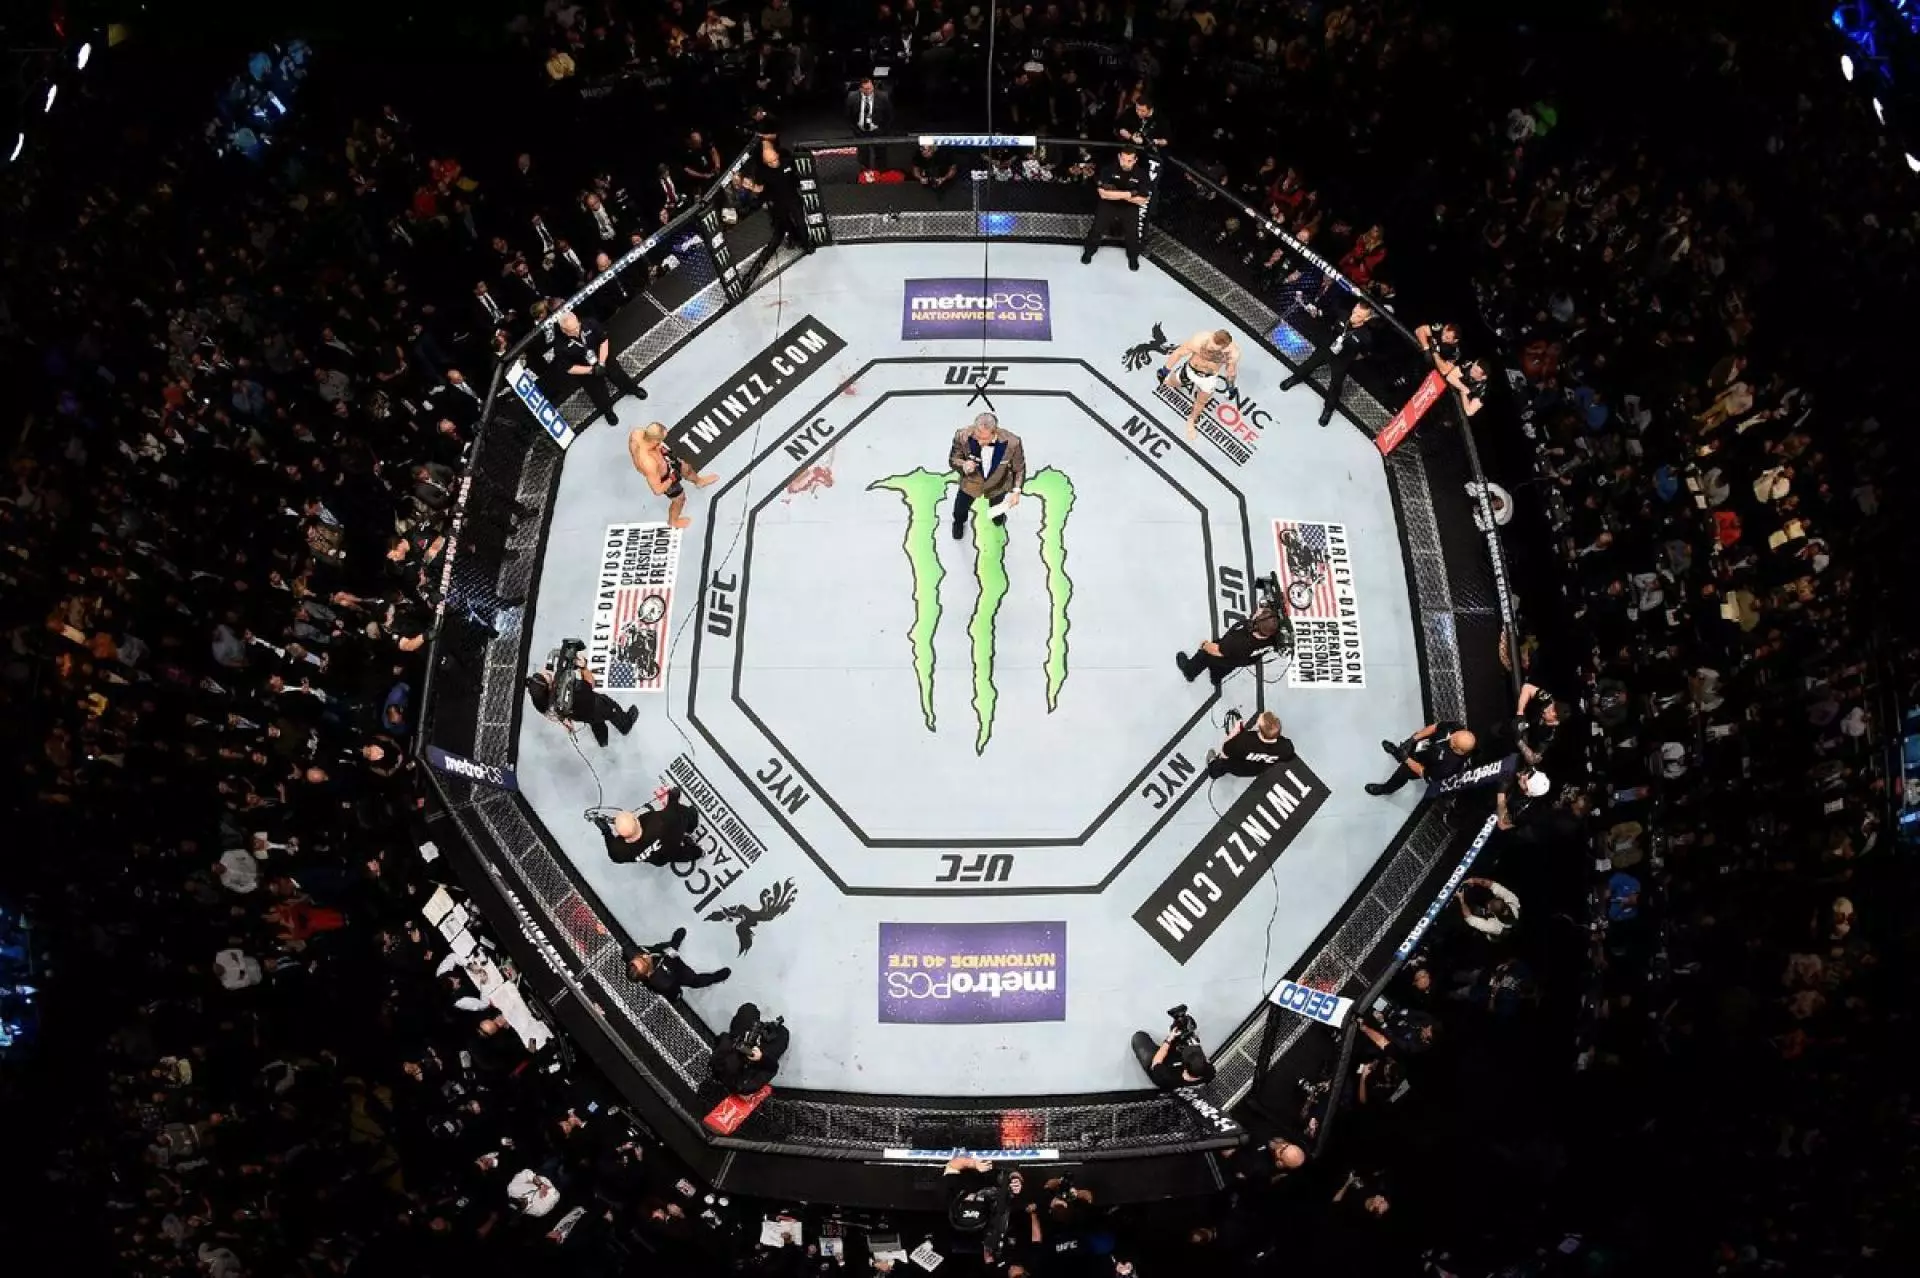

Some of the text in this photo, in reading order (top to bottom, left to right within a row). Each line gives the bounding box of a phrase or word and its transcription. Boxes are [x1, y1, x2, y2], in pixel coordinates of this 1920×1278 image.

[911, 311, 1043, 321] NATIONWIDE 4G LTE
[678, 328, 828, 455] TWINZZ.COM
[944, 366, 1008, 385] UFC
[516, 372, 567, 438] GEICO
[1216, 402, 1259, 441] OFF
[784, 417, 835, 462] NYC
[1121, 415, 1172, 459] NYC
[1200, 419, 1251, 465] EVERYTHING
[621, 528, 641, 586] OPERATION
[634, 528, 655, 585] PERSONAL
[649, 527, 671, 585] FREEDOM
[594, 528, 625, 689] HARLEY-DAVIDSON
[707, 570, 737, 638] UFC
[1327, 524, 1363, 684] HARLEY-DAVIDSON
[1295, 621, 1316, 683] FREEDOM
[1312, 621, 1330, 682] PERSONAL
[1326, 621, 1343, 683] OPERATION
[444, 755, 504, 785] metroPCS
[756, 757, 811, 815] NYC
[1142, 752, 1196, 809] NYC
[1246, 752, 1279, 763] UFC
[670, 756, 762, 864] WINNING IS EVERYTHING
[935, 853, 1015, 882] UFC
[1156, 768, 1313, 942] TWINZZ.COM
[887, 952, 1057, 968] NATIONWIDE 4G LTE
[1279, 983, 1340, 1021] GEICO
